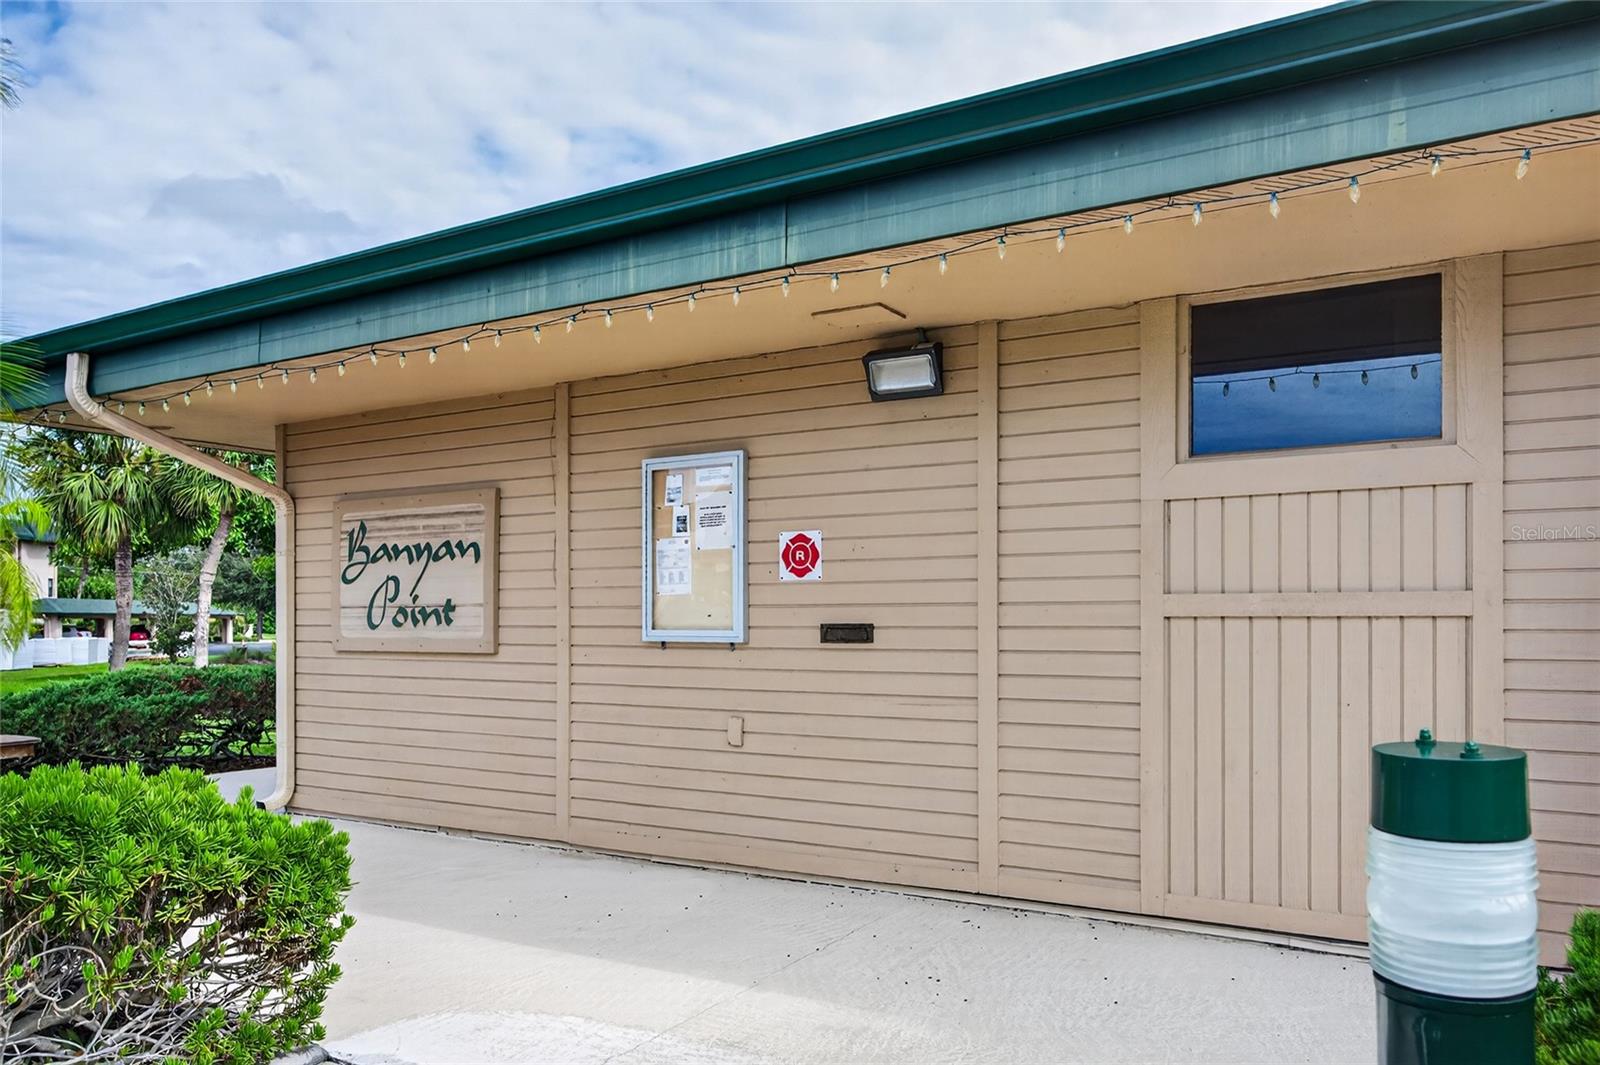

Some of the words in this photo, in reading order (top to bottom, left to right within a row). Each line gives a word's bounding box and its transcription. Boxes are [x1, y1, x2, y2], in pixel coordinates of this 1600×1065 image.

[341, 520, 481, 597] Banyan
[796, 551, 805, 561] R
[367, 575, 456, 631] Point
